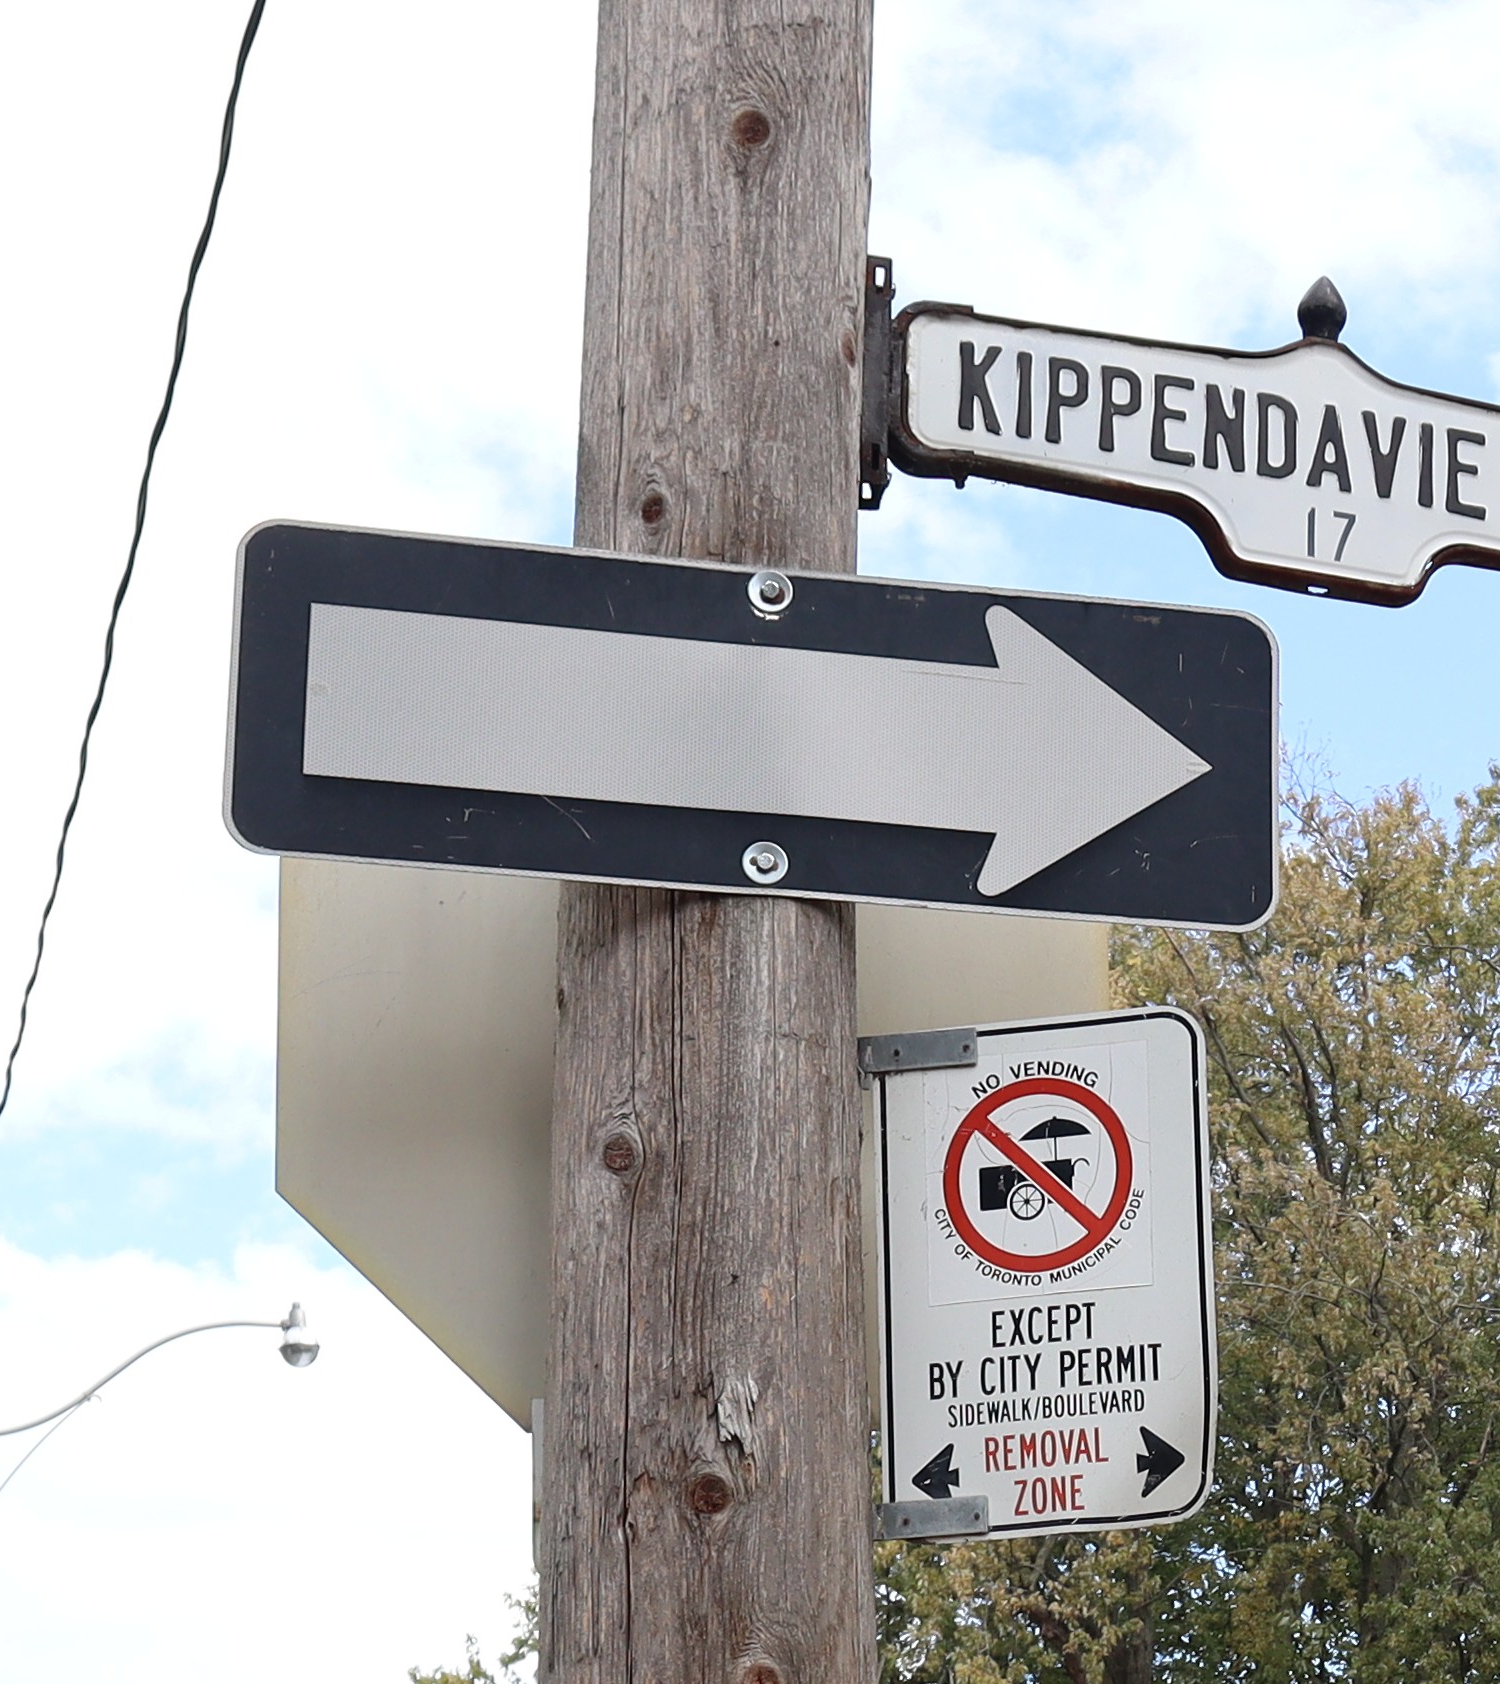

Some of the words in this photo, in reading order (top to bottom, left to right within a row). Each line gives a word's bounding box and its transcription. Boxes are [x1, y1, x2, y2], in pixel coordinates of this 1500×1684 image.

[958, 340, 1488, 521] KIPPENDAVIE
[1306, 506, 1357, 563] 17
[971, 1074, 1001, 1099] NO
[1009, 1060, 1100, 1088] VENDING
[934, 1208, 956, 1241] CITY
[954, 1243, 973, 1266] OF
[975, 1260, 1042, 1287] TORONTO
[1050, 1236, 1122, 1284] MUNICIPAL
[1119, 1188, 1145, 1231] CODE
[991, 1302, 1096, 1348] EXCEPT
[929, 1360, 964, 1400] BY
[980, 1352, 1042, 1396] CITY
[1059, 1343, 1162, 1388] PERMIT
[948, 1389, 1145, 1428] SIDEWALK/BOULEVARD
[984, 1427, 1109, 1473] REMOVAL
[1014, 1474, 1085, 1516] ZONE
